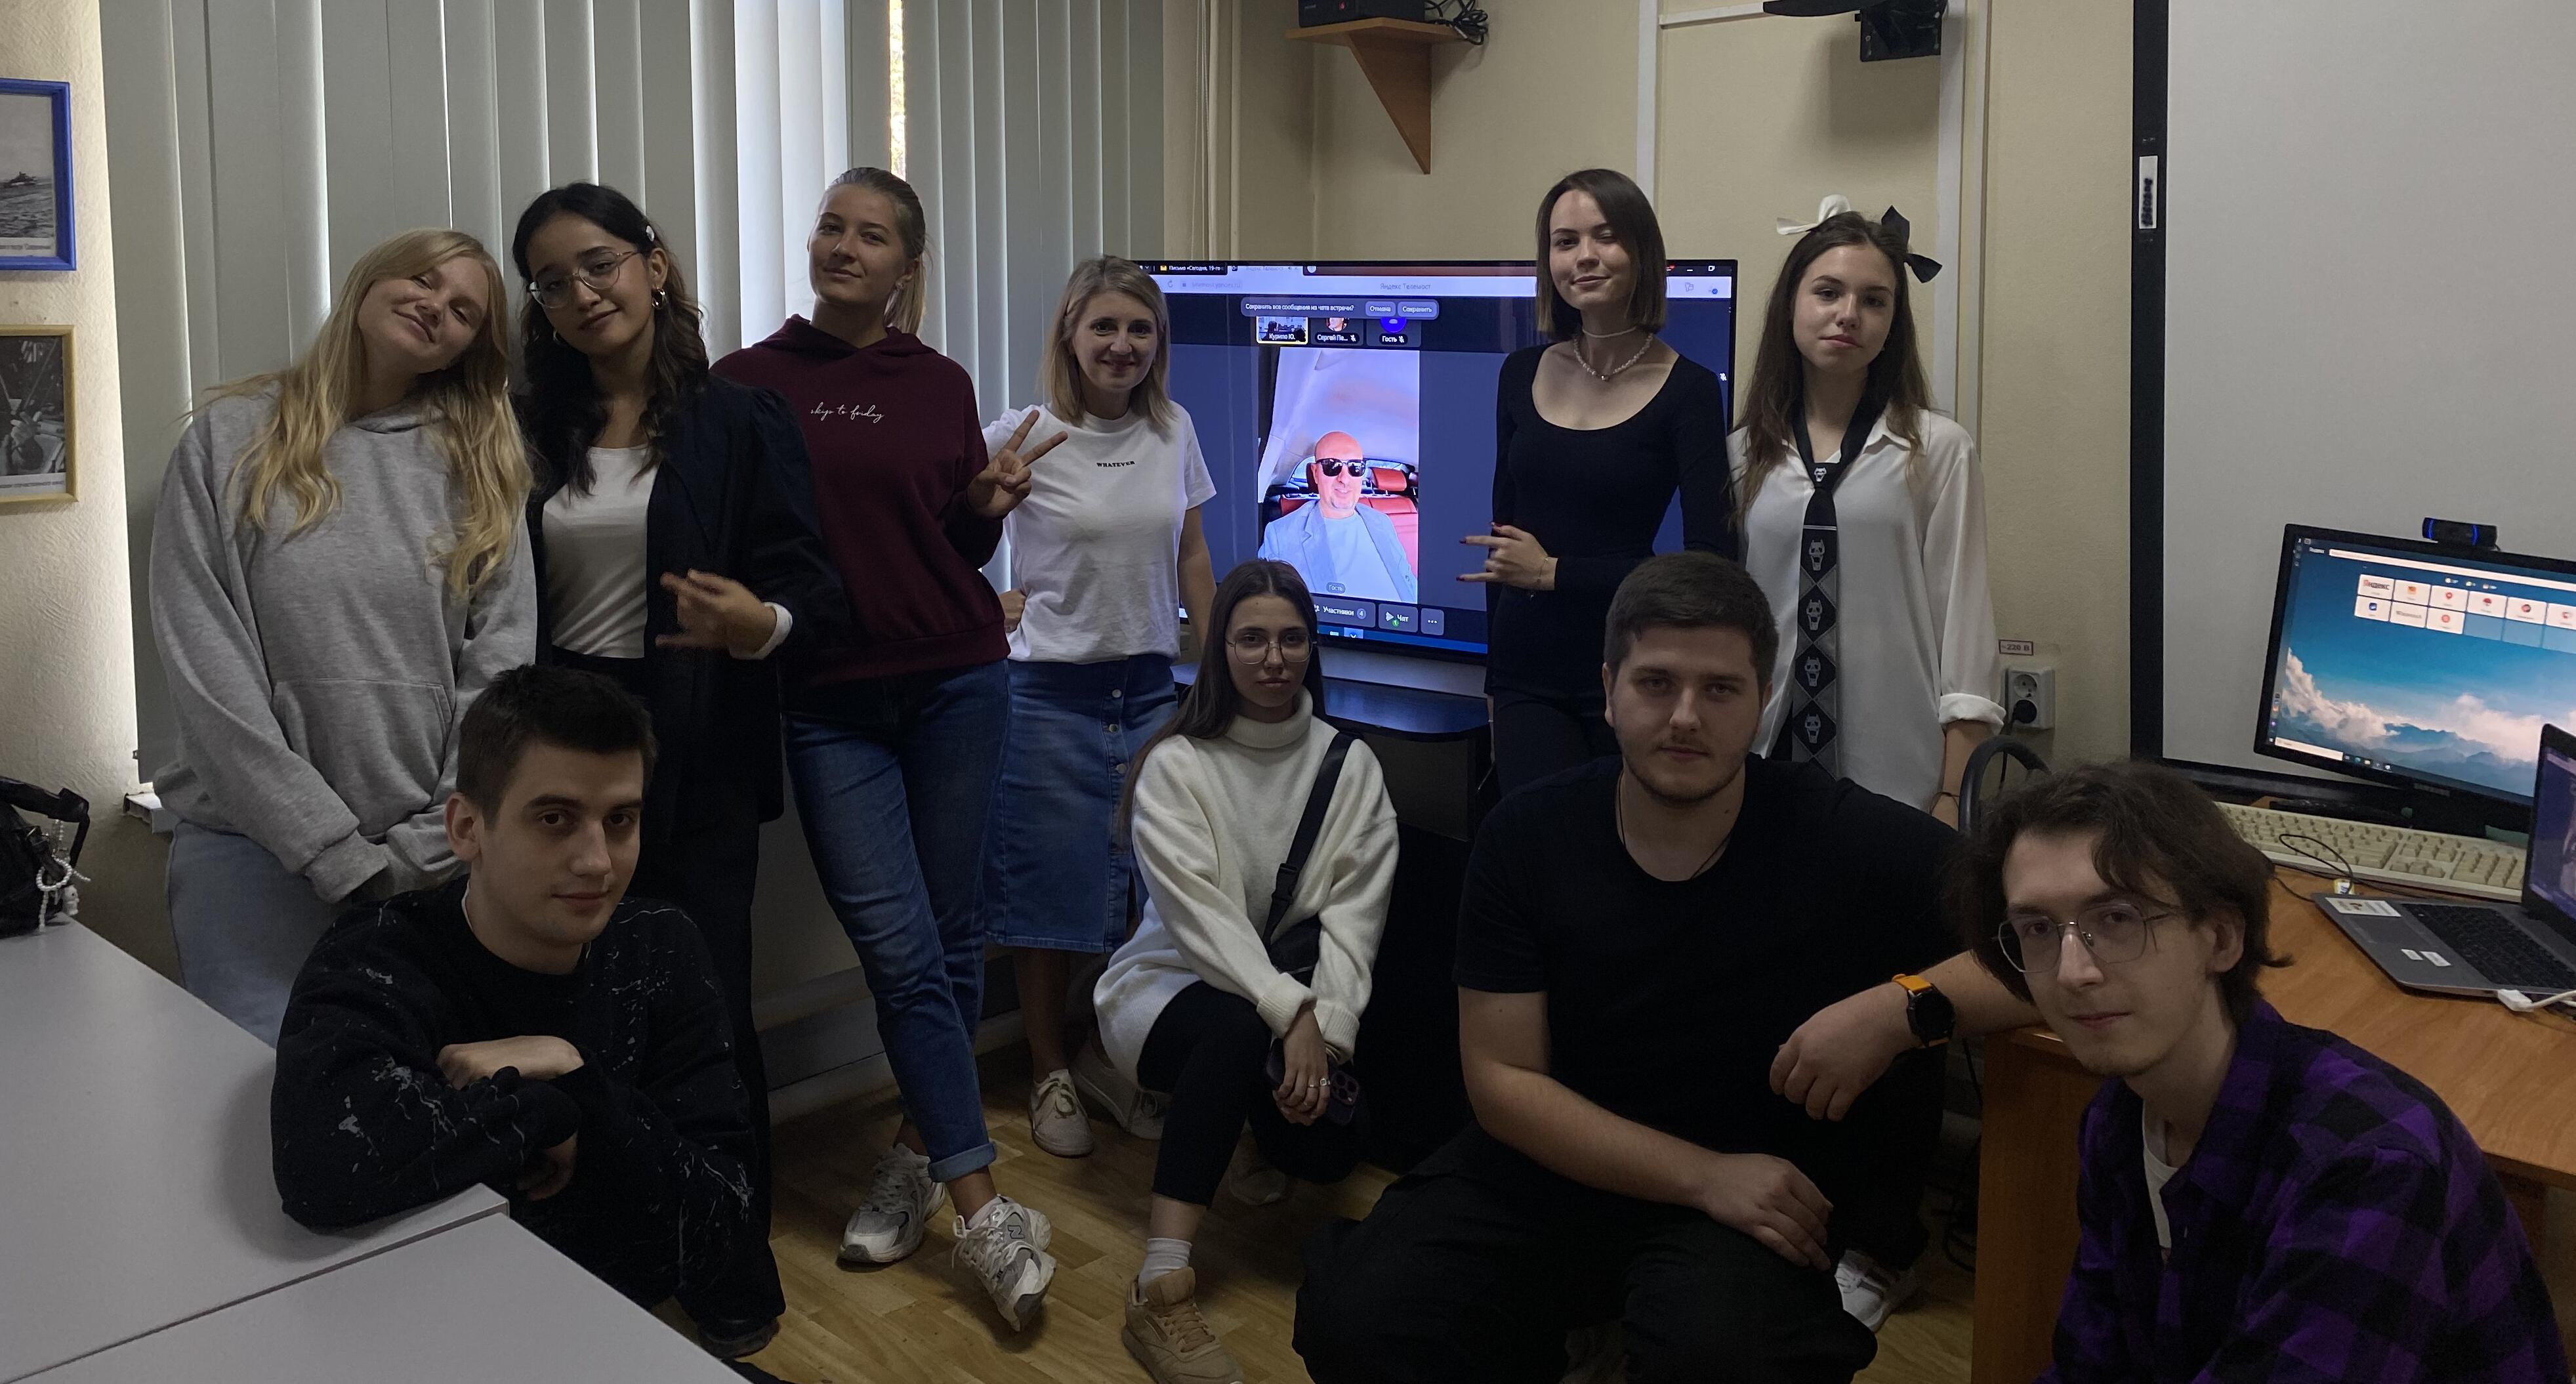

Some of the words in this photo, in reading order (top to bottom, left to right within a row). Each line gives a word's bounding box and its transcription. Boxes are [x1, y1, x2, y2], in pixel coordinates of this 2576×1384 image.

[836, 404, 848, 415] to
[850, 404, 885, 423] friday
[1323, 606, 1354, 616] Участники
[1397, 614, 1409, 622] Чат
